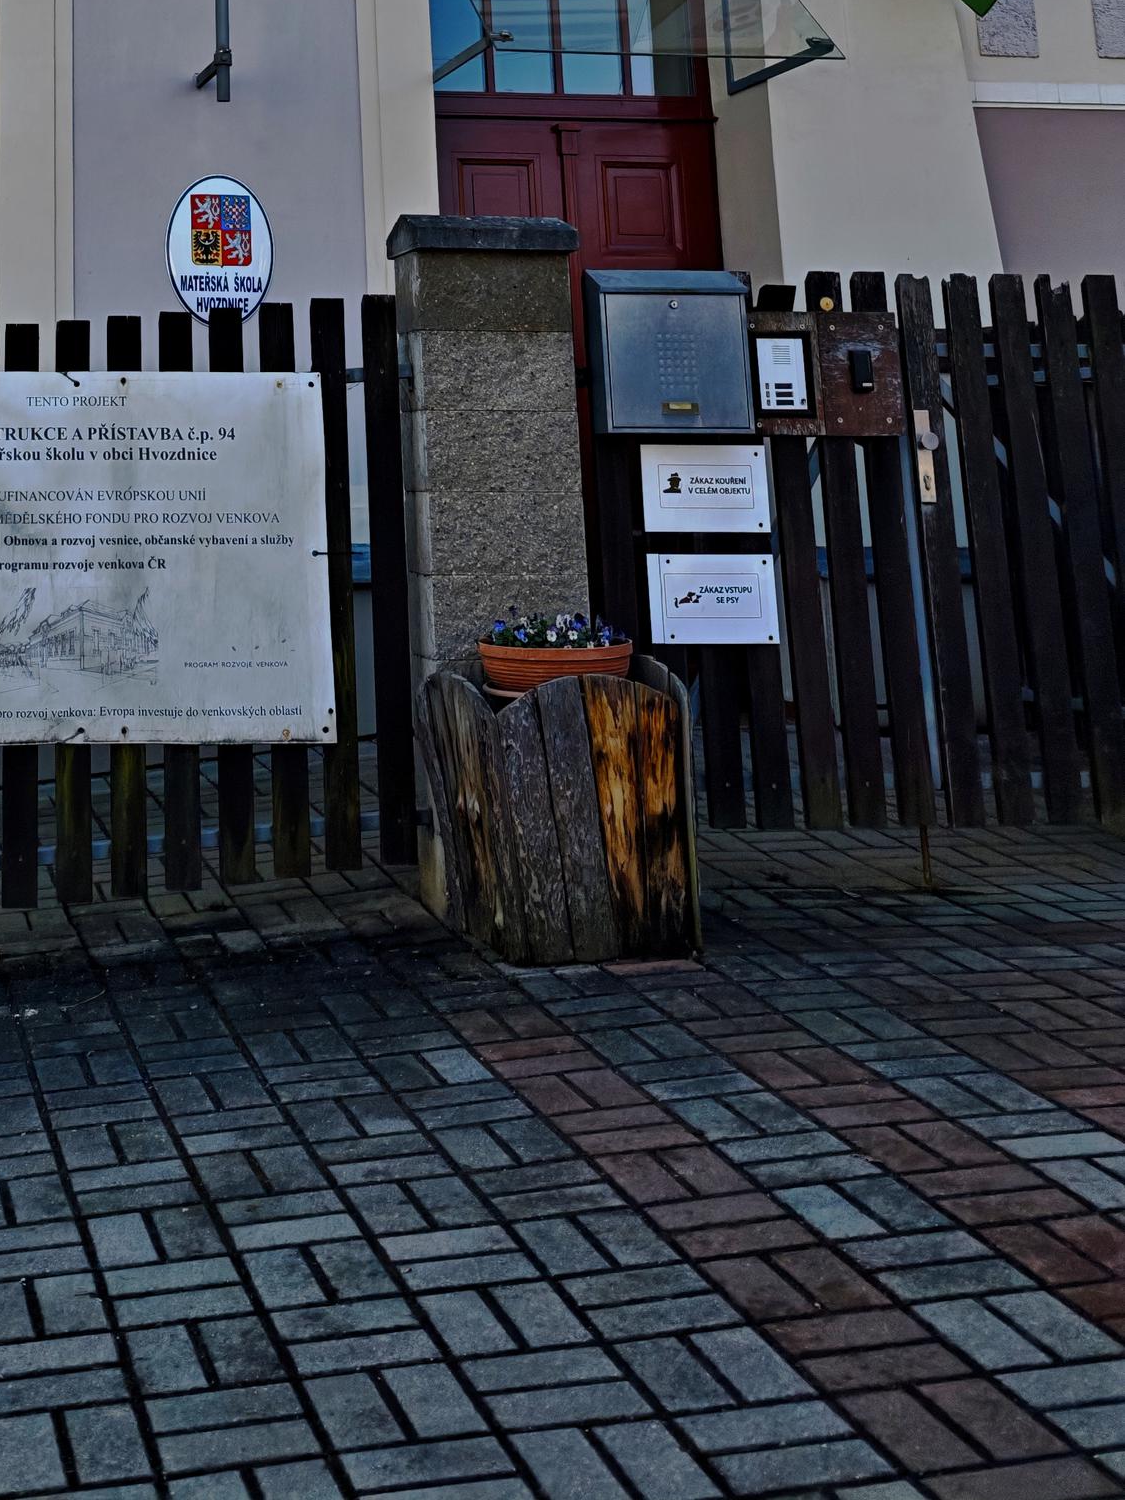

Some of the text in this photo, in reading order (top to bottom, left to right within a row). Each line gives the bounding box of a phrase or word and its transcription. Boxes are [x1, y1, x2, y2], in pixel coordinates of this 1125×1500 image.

[181, 272, 262, 292] MATEŘSKÁ ŠKOLA
[26, 396, 128, 407] TENTO PROJEKT
[72, 427, 83, 441] A
[87, 423, 184, 441] PŘÍSTAVBA
[188, 427, 213, 444] č.p.
[218, 427, 235, 441] 94
[45, 447, 85, 461] školu
[89, 451, 98, 460] v
[103, 447, 134, 461] obci
[138, 447, 217, 461] Hvozdnice
[690, 476, 714, 484] ZÁKAZ
[695, 486, 718, 494] CELÉM
[85, 513, 130, 524] FONDU
[134, 513, 159, 524] PRO
[162, 513, 212, 524] ROZVOJ
[216, 513, 280, 524] VENKOVA
[4, 535, 48, 546] Obnova
[61, 535, 95, 548] rozvoj
[99, 535, 142, 547] vesnice,
[144, 534, 196, 546] občanské
[199, 534, 248, 548] vybavení
[251, 537, 257, 545] a
[260, 534, 294, 547] služby
[52, 560, 95, 572] rozvoje
[98, 558, 144, 569] venkova
[148, 556, 166, 569] ČR
[699, 585, 724, 594] ZÁKAZ
[221, 661, 252, 669] ROZVOJE
[16, 708, 48, 720] rozvoj
[51, 708, 95, 718] venkova:
[99, 707, 135, 718] Evropa
[137, 706, 183, 719] investuje
[186, 705, 199, 717] do
[201, 705, 266, 718] venkovských
[269, 705, 302, 716] oblastí
